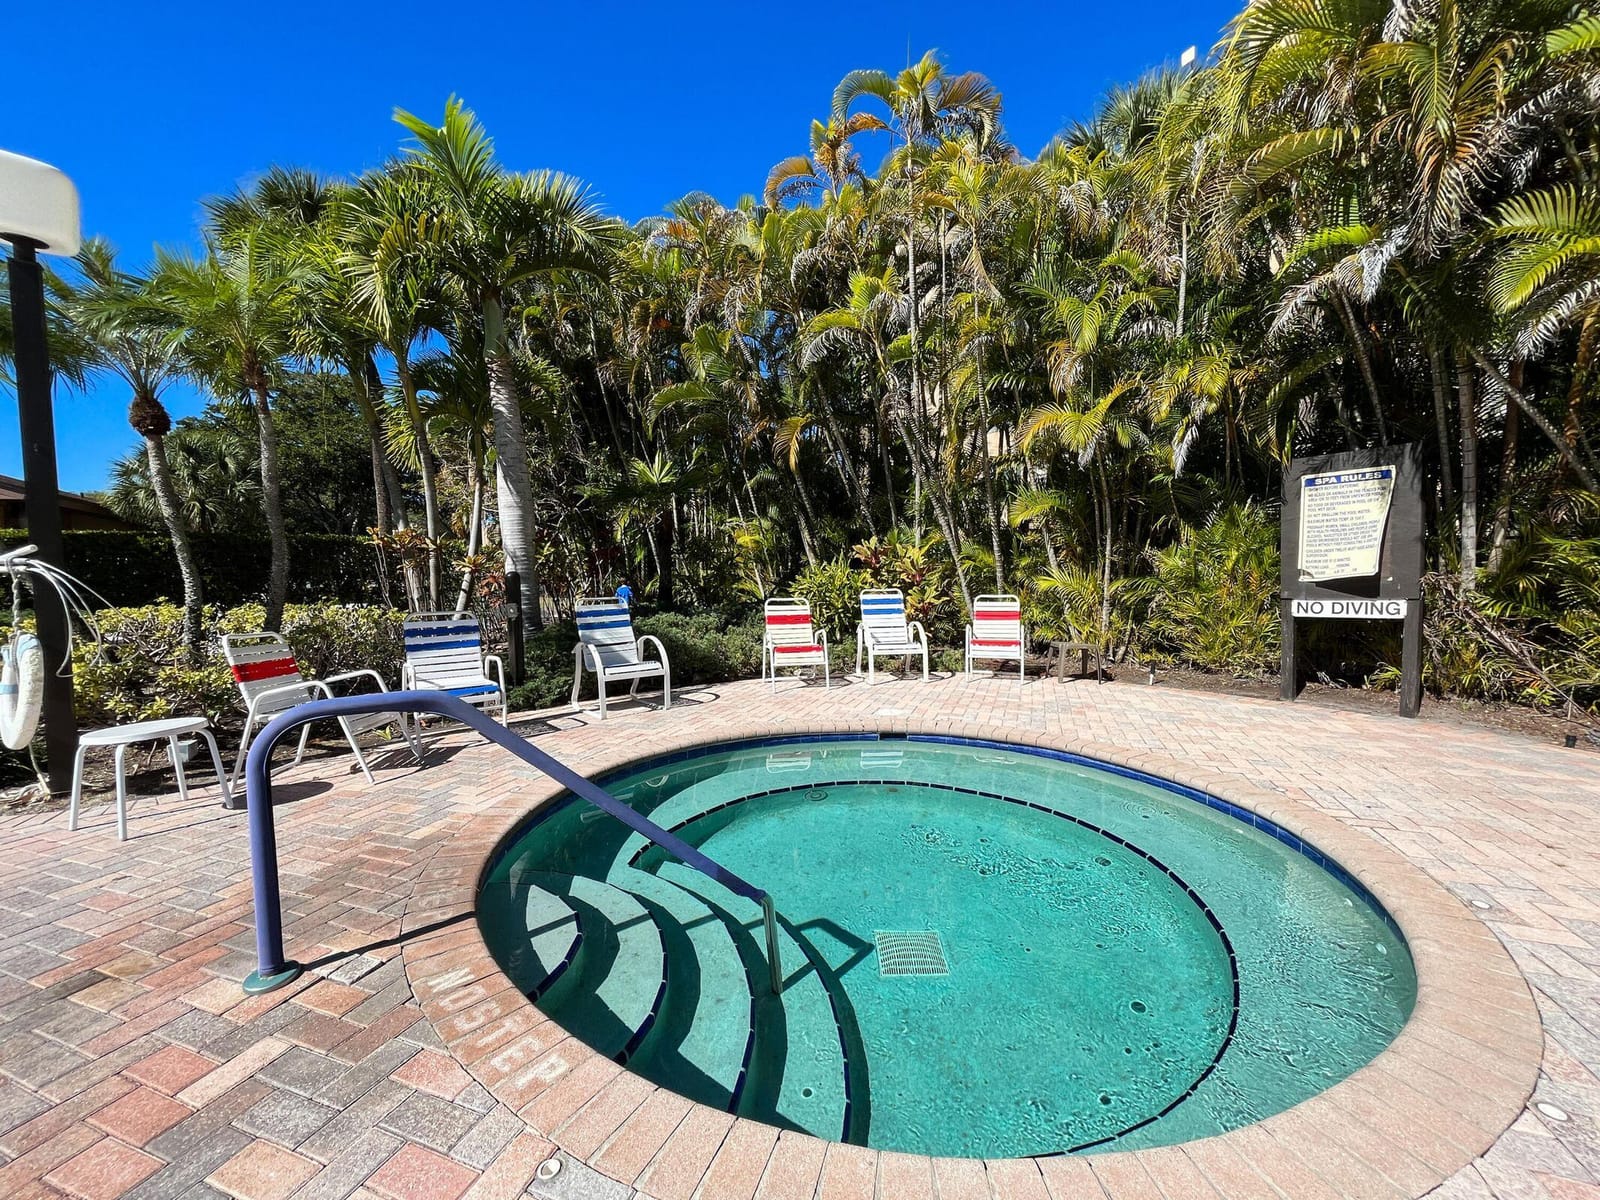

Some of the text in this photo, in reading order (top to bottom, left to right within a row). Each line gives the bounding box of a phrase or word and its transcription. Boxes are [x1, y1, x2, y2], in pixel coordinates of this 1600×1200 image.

[1315, 472, 1382, 485] SPA RULES
[1297, 601, 1401, 615] NO DIVING
